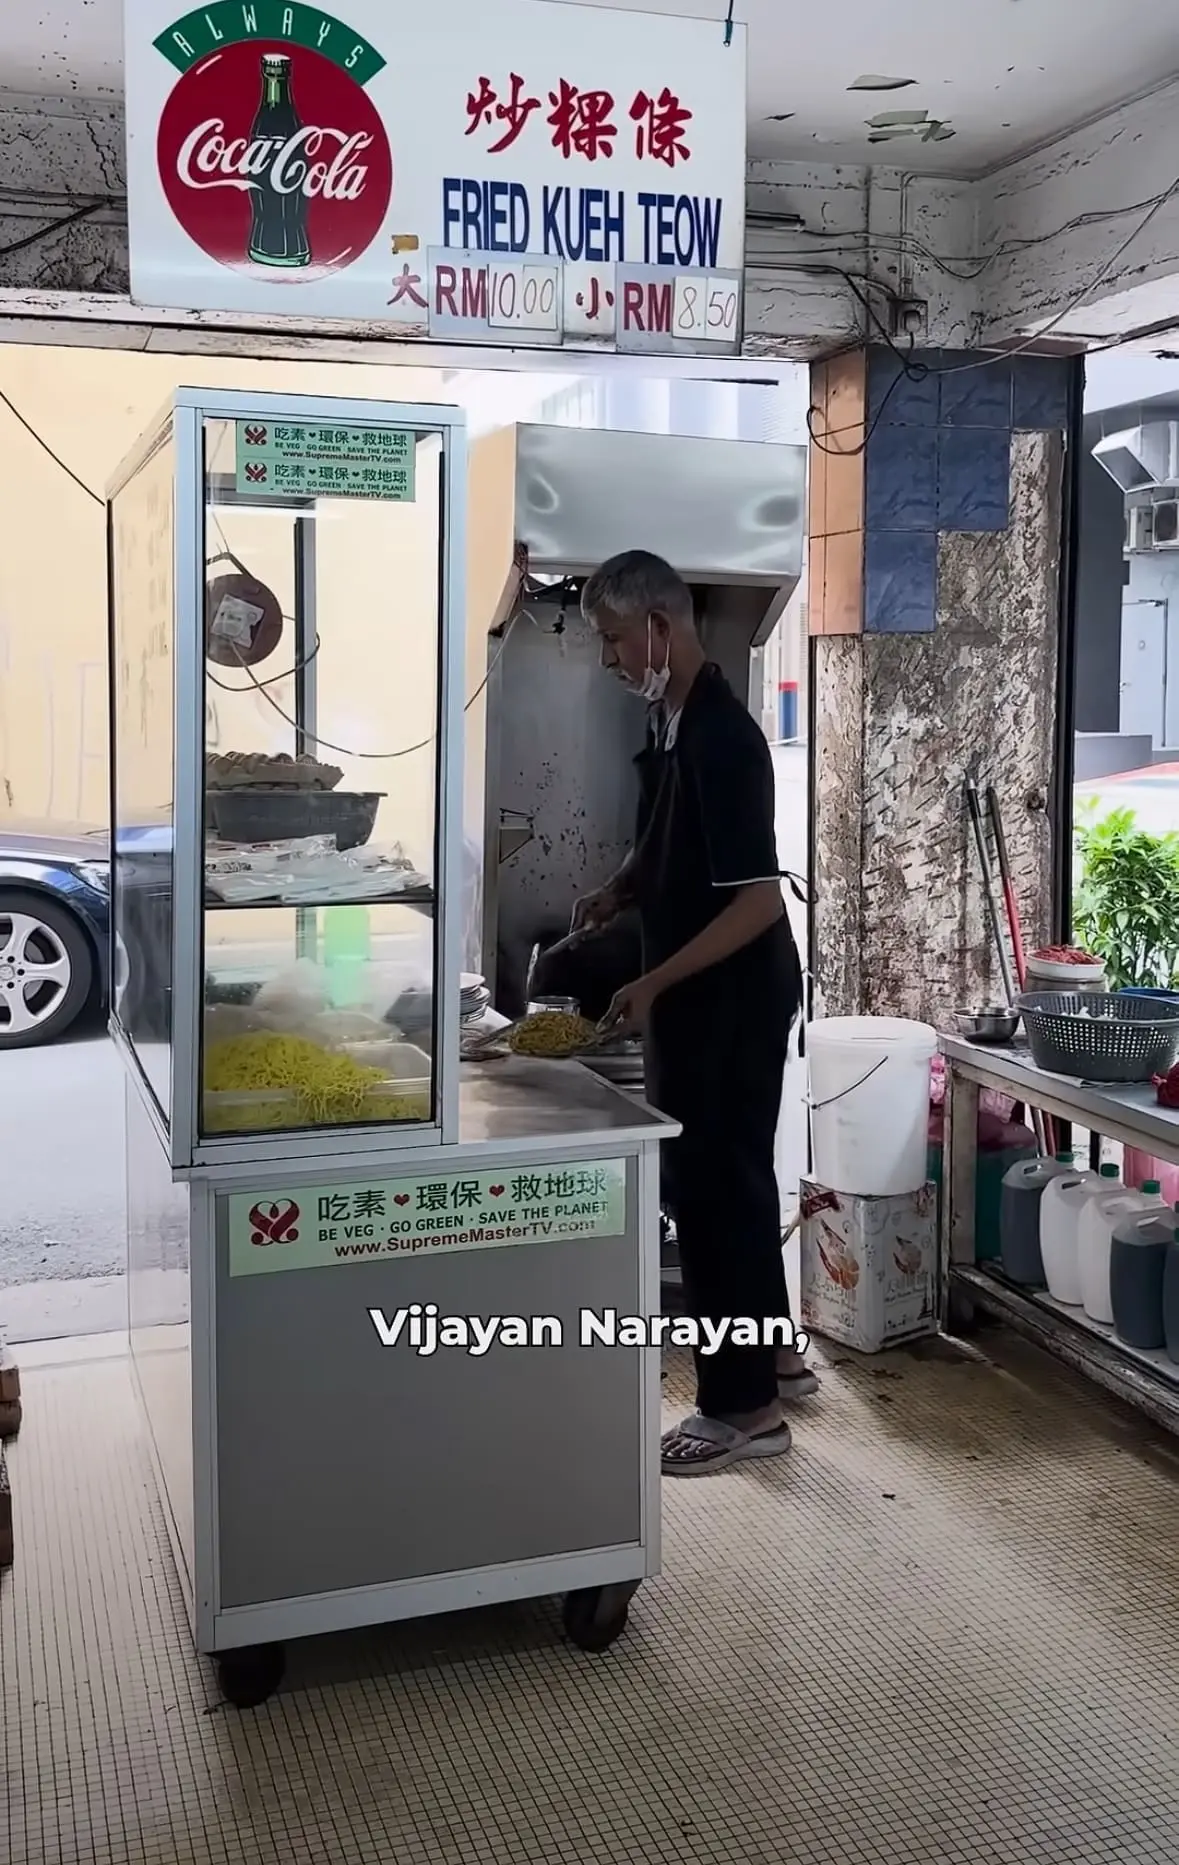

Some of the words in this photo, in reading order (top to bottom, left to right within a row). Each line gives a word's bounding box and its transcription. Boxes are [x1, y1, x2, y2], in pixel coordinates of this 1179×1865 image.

[171, 4, 364, 68] ALWAYS
[464, 72, 693, 168] 炒粿條
[176, 118, 374, 200] Coca-Cola
[442, 177, 530, 253] FRIED
[542, 185, 624, 262] KUEH
[637, 191, 722, 268] TEOW
[386, 263, 429, 308] 大
[575, 277, 614, 320] 小
[274, 441, 283, 449] BE
[286, 442, 301, 450] VEG
[306, 443, 318, 451] GO
[318, 444, 342, 452] GREEN
[347, 446, 365, 454] SAVE
[282, 450, 401, 464] www.SupremeMasterTV.com
[282, 487, 401, 499] www.SupremeMasterTV.com
[286, 479, 301, 487] VEG
[306, 480, 318, 488] GO
[318, 481, 342, 489] GREEN
[382, 485, 408, 493] PLANET
[317, 1189, 387, 1222] 吃素
[416, 1180, 483, 1212] 環保
[511, 1168, 607, 1203] 救地球
[318, 1228, 337, 1242] BE
[344, 1224, 374, 1239] VEG
[390, 1220, 411, 1234] GO
[415, 1215, 464, 1231] GREEN
[478, 1209, 516, 1225] SAVE
[522, 1206, 550, 1221] THE
[554, 1201, 608, 1217] PLANET
[335, 1220, 595, 1257] www.SupremeMasterTV.com
